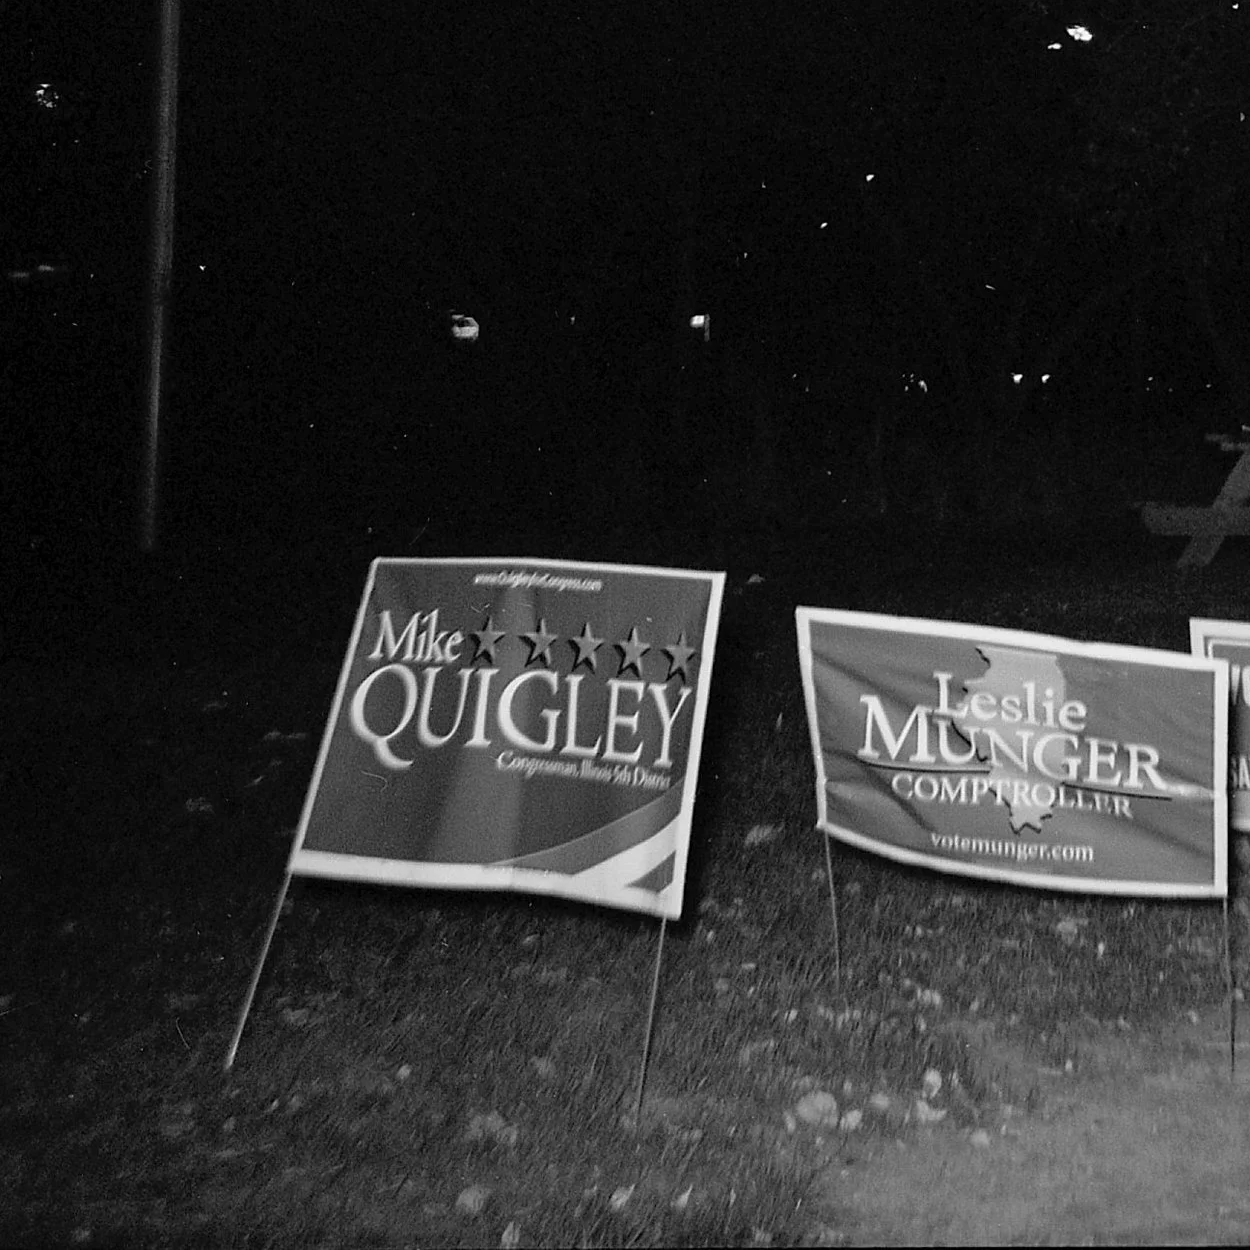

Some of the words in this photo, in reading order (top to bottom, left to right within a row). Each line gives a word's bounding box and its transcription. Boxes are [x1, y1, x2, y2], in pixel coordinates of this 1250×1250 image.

[368, 609, 466, 664] Mike
[350, 664, 692, 769] QUIGLEY
[932, 671, 1087, 732] Leslie
[857, 694, 1170, 793] MUNGER
[891, 773, 1134, 819] COMPTROLLER
[930, 831, 1094, 864] votemunger.com
